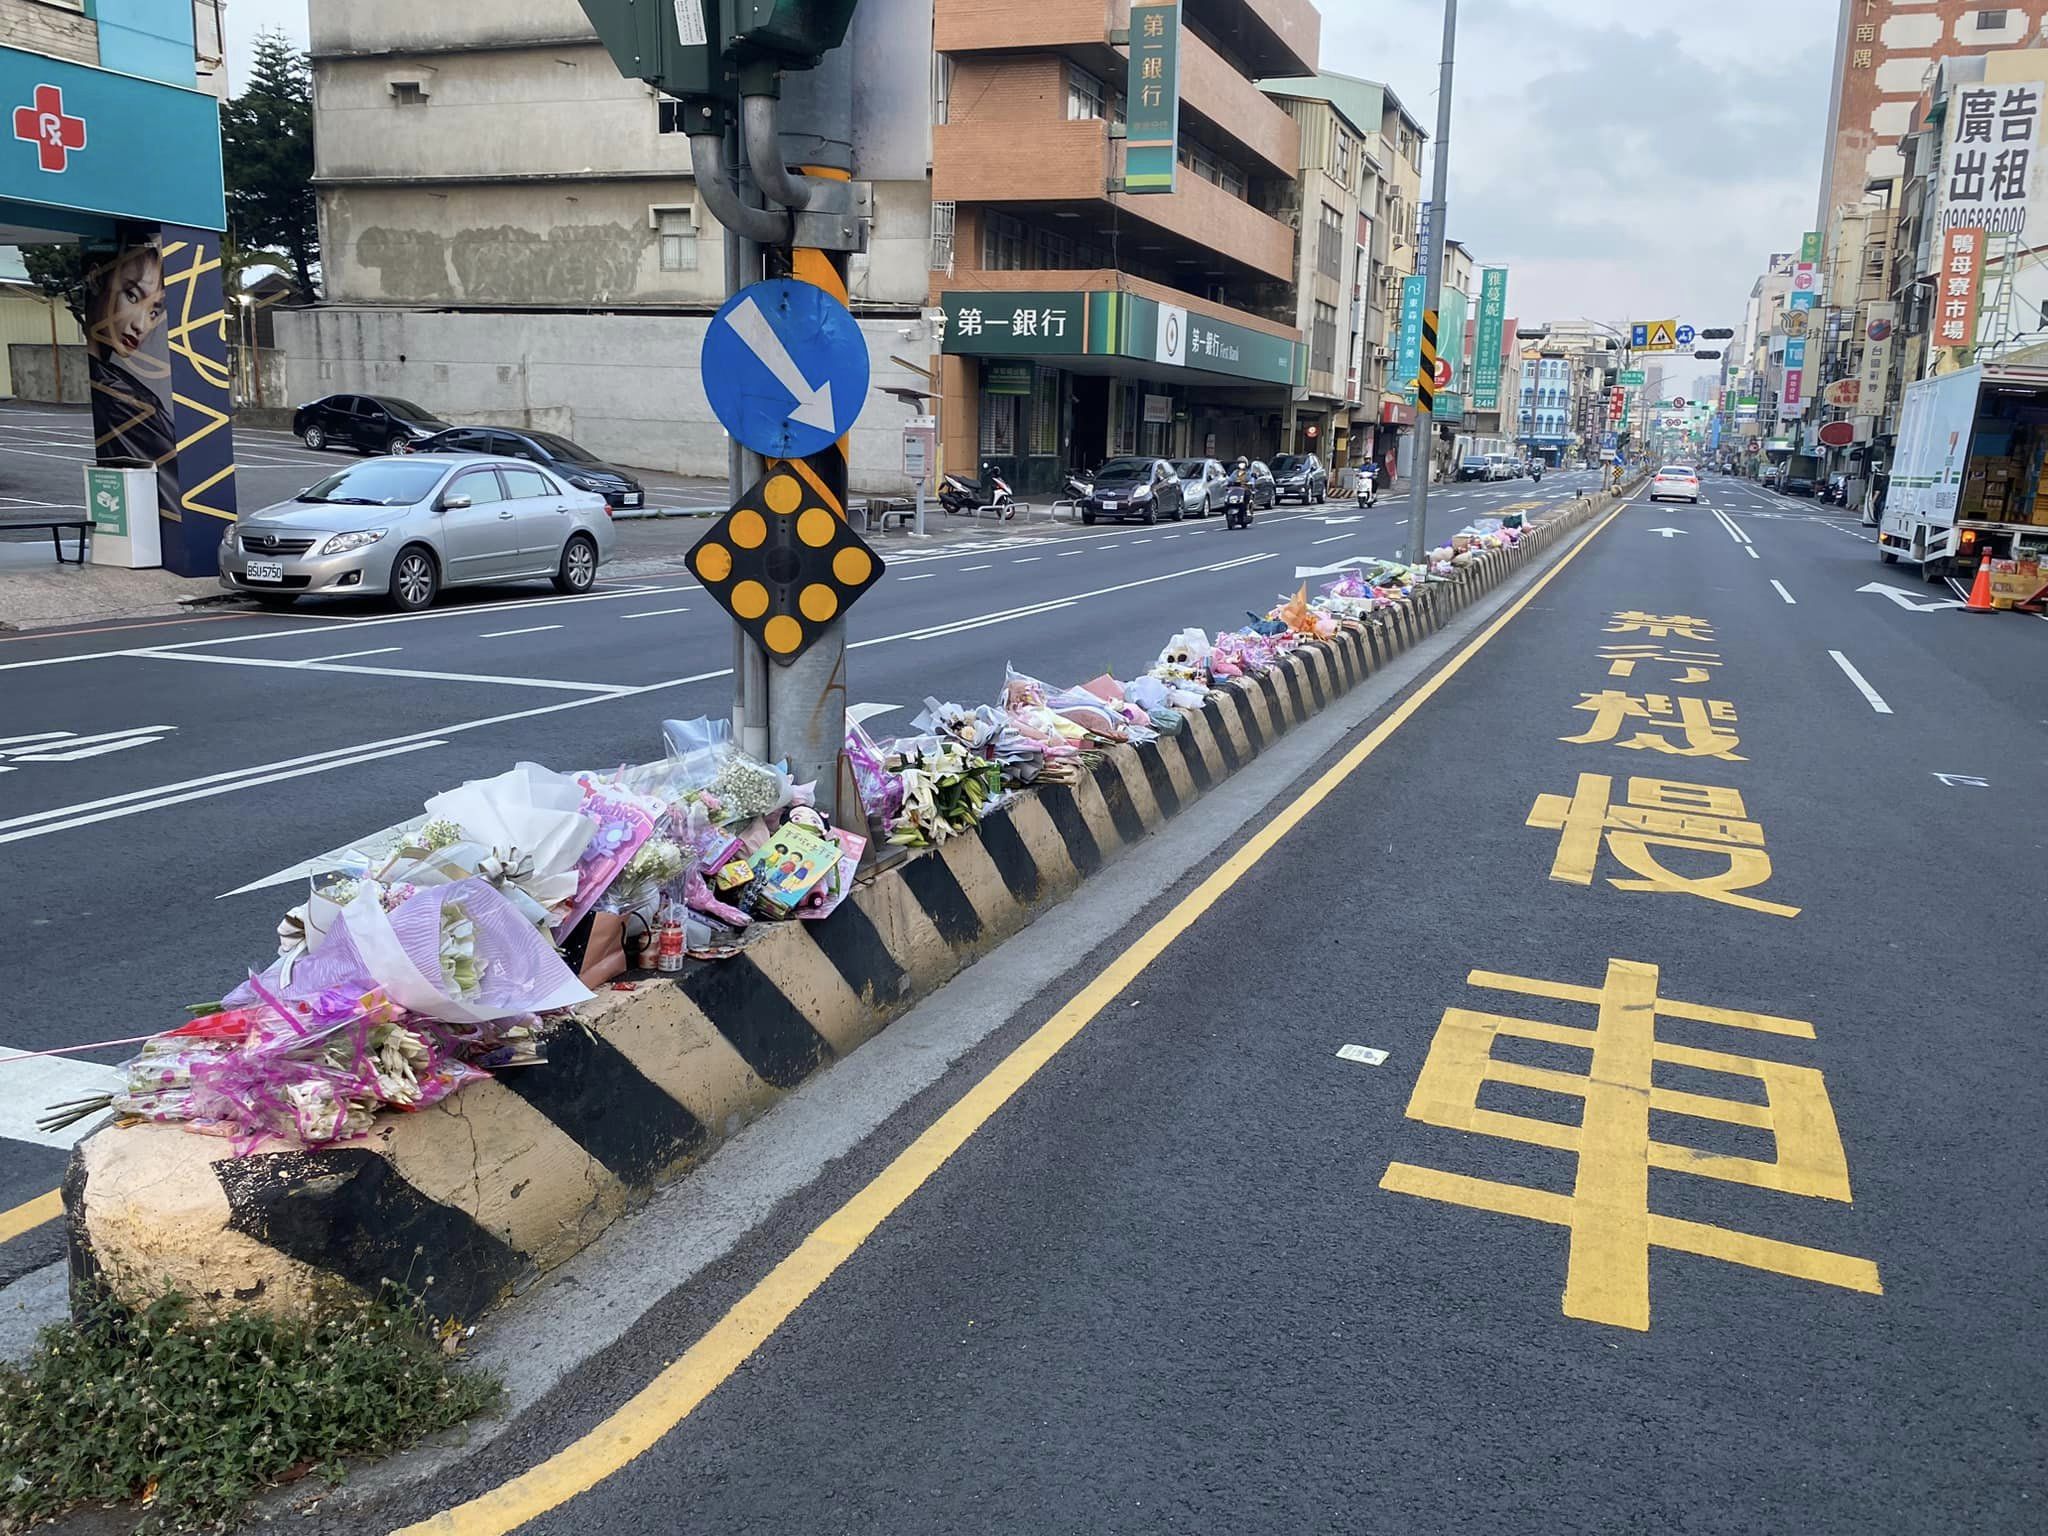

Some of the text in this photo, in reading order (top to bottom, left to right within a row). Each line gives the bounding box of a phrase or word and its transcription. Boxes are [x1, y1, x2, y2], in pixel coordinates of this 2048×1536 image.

[1141, 14, 1164, 107] 第一銀行
[1955, 88, 2037, 143] 廣告
[1949, 149, 2029, 202] 出租
[1942, 234, 1975, 339] 鴨母寮市場
[957, 308, 1067, 336] 第一銀行
[1192, 328, 1220, 358] 第一銀行
[1475, 399, 1495, 408] 24H
